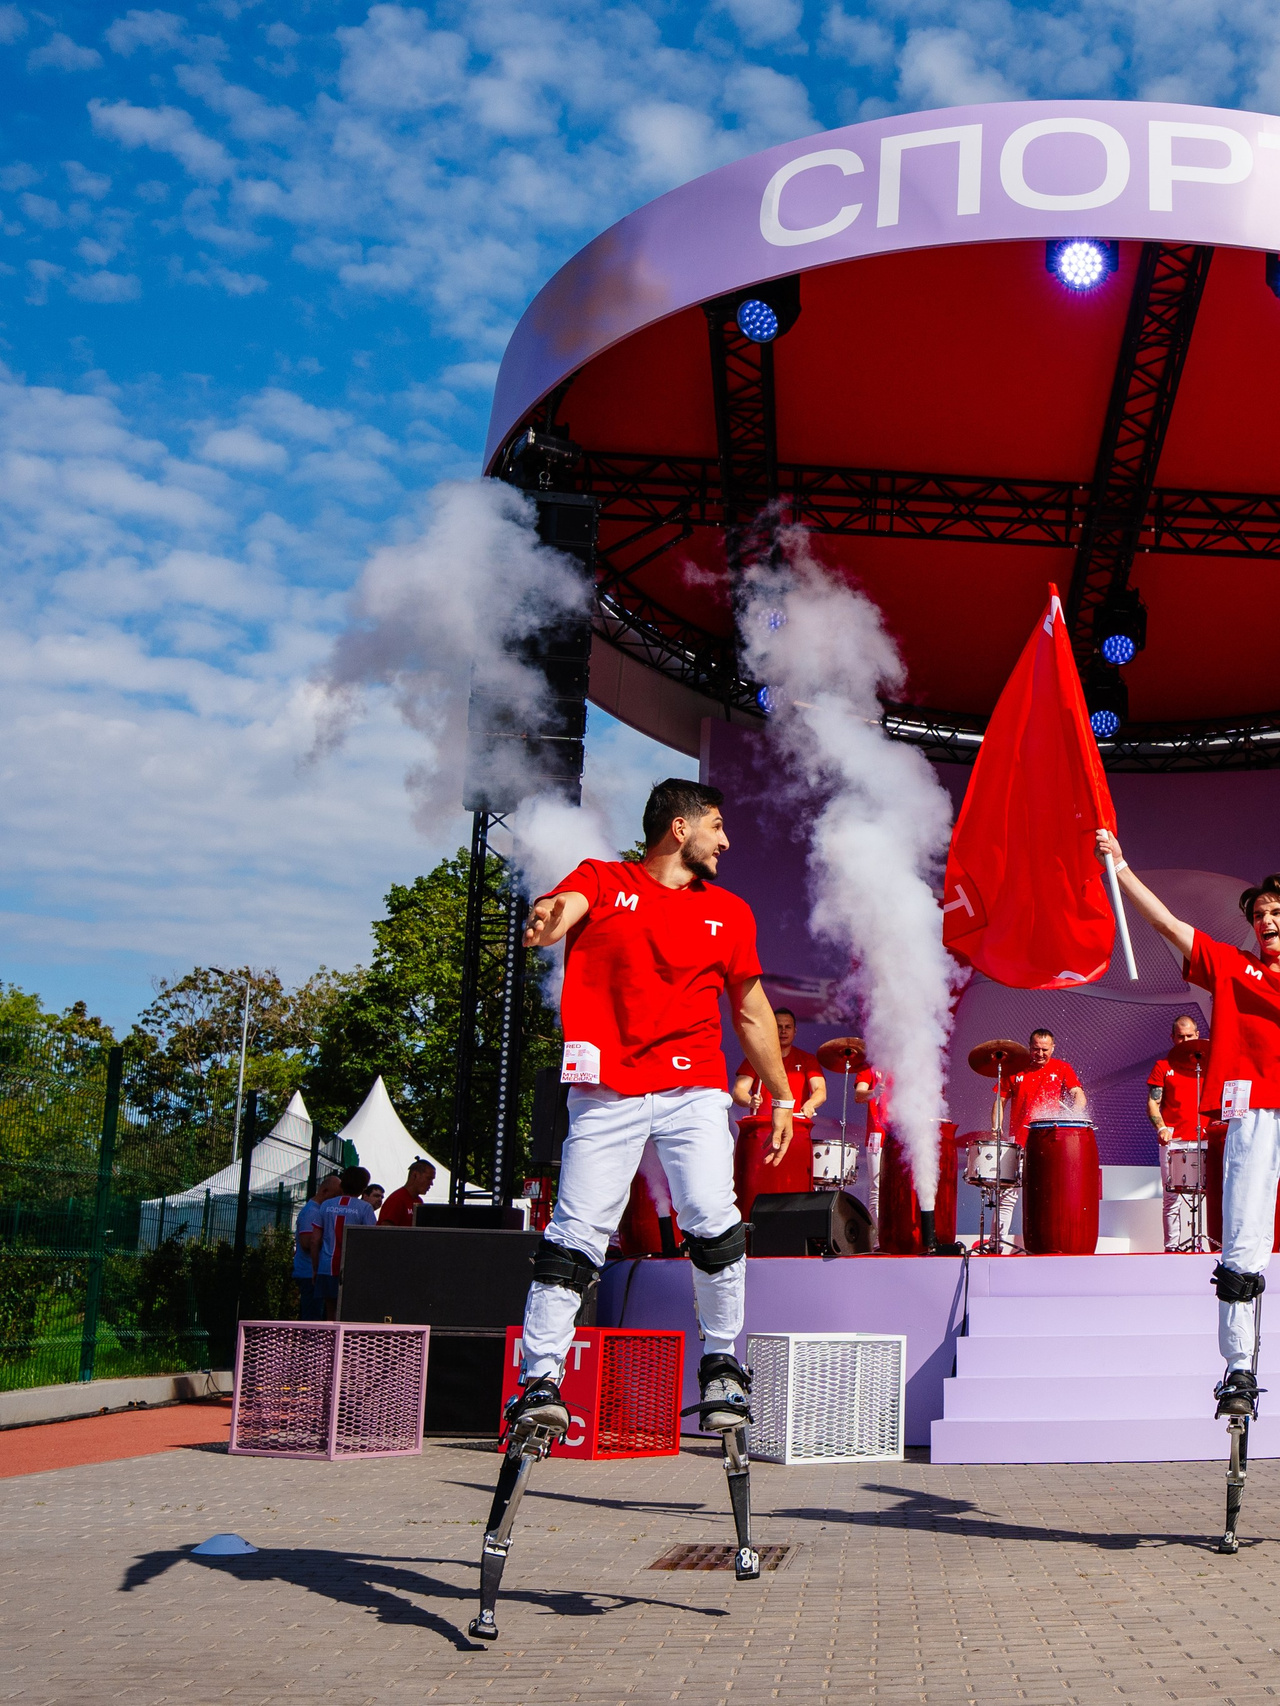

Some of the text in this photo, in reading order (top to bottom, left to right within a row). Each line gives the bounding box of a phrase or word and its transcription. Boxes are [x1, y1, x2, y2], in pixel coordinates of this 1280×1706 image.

[614, 891, 723, 936] М Т
[1245, 964, 1263, 980] М
[672, 1056, 692, 1070] С
